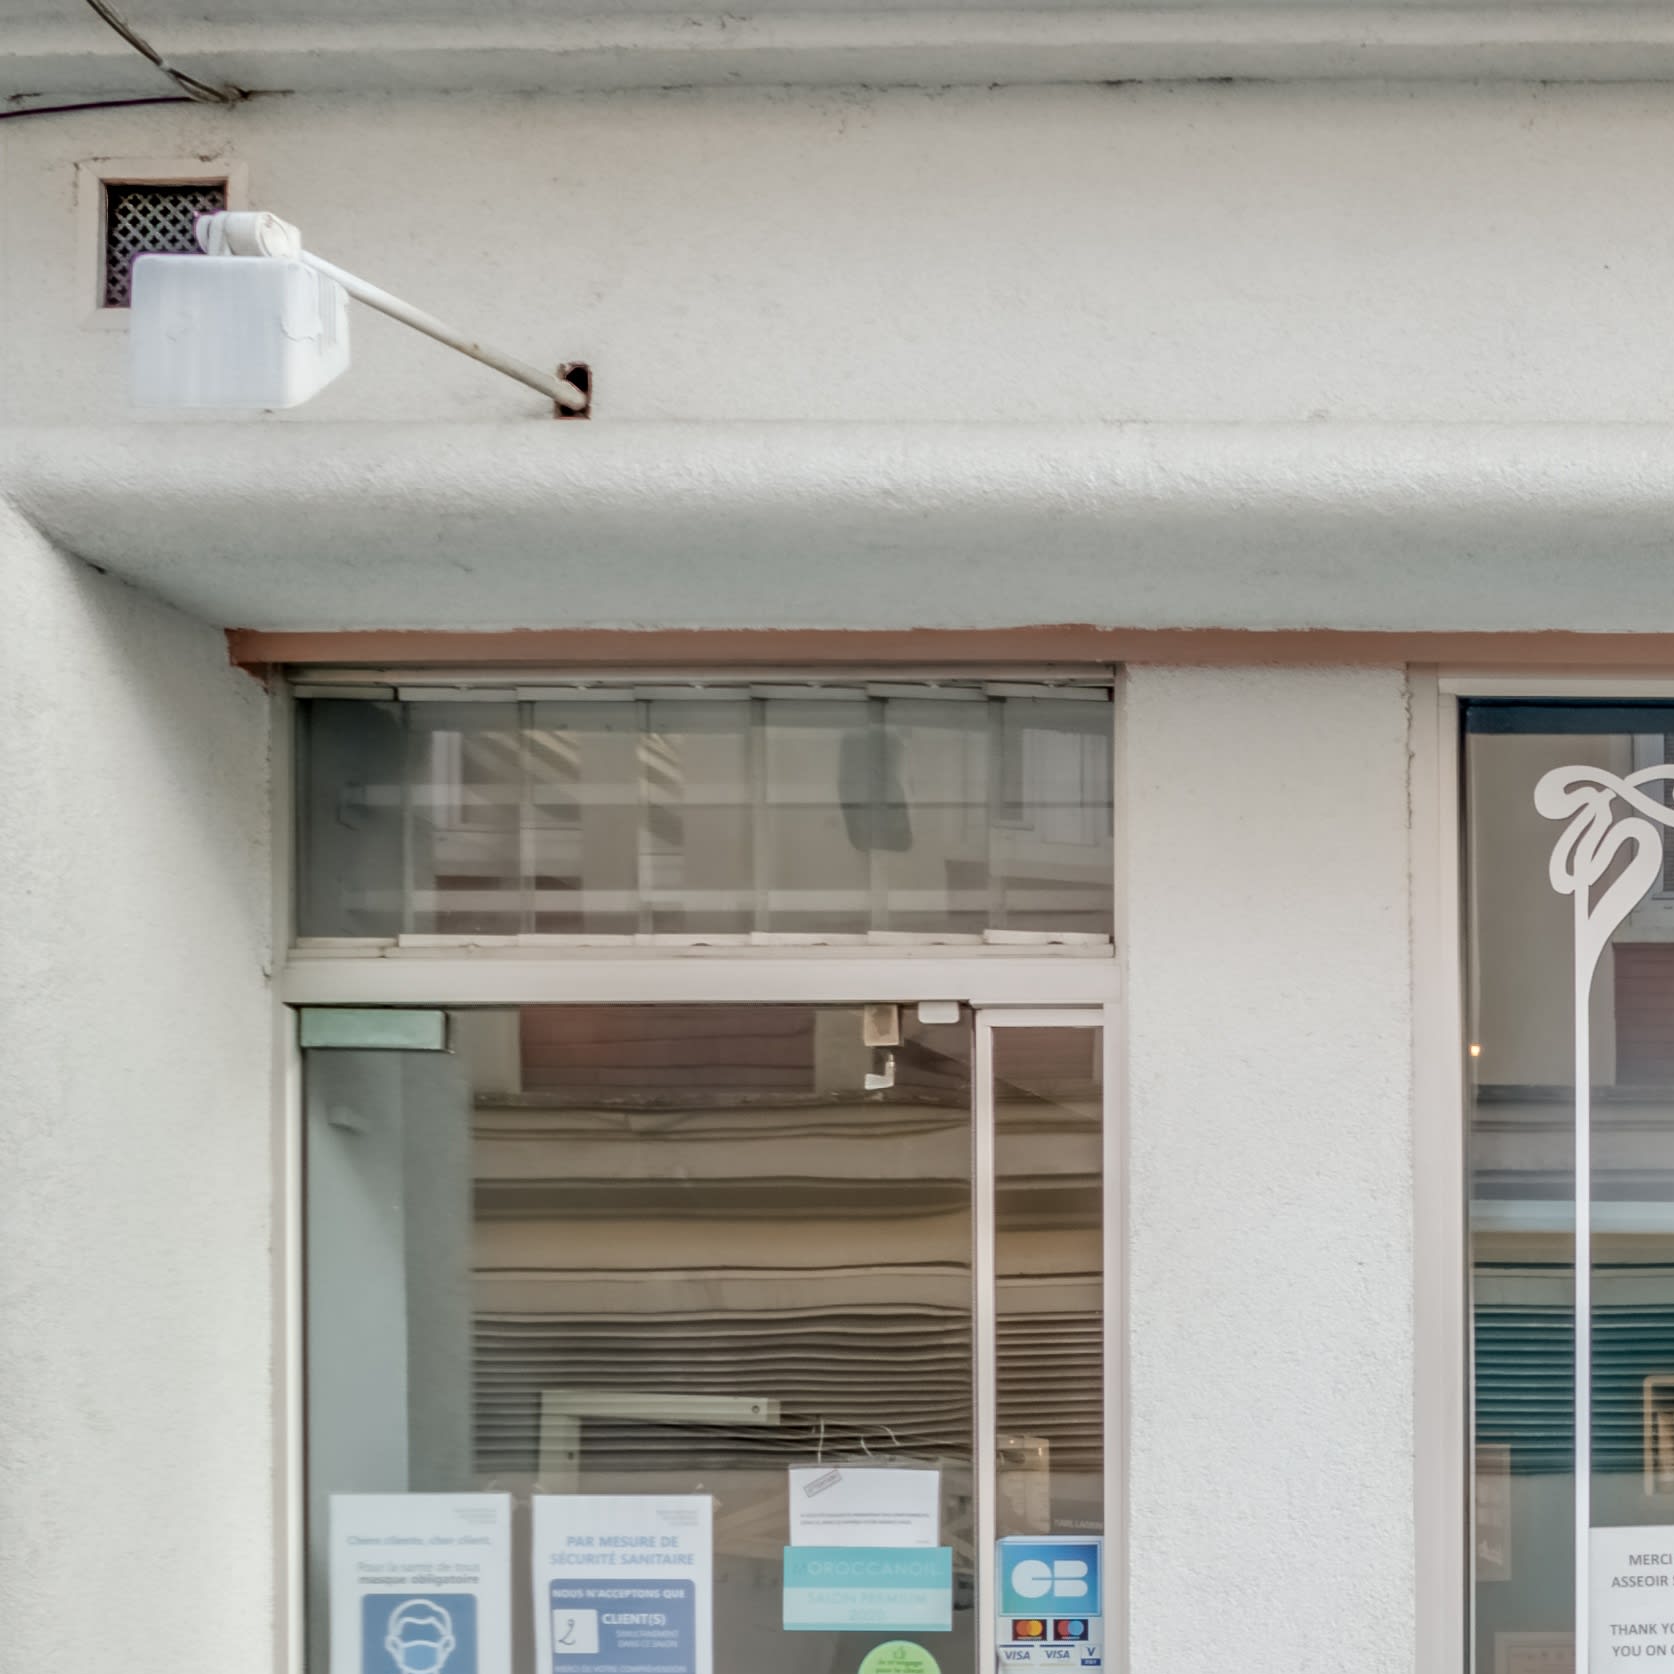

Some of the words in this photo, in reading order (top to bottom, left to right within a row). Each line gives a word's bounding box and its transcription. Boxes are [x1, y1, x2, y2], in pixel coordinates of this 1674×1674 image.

[566, 1536, 594, 1548] PAR
[598, 1536, 657, 1548] MESURE
[660, 1536, 680, 1548] DE
[550, 1551, 617, 1565] SÉCURITÉ
[620, 1553, 695, 1565] SANITAIRE
[1628, 1553, 1672, 1566] MERCI
[357, 1576, 406, 1587] masque
[410, 1573, 480, 1587] obligatoire
[1011, 1559, 1089, 1599] CB
[1611, 1575, 1668, 1588] ASSEOIR
[552, 1588, 584, 1599] NOUS
[586, 1588, 660, 1599] N'ACCEPTONS
[663, 1588, 686, 1599] QUE
[601, 1612, 667, 1626] CLIENT(S)
[1610, 1623, 1658, 1636] THANK
[1004, 1650, 1031, 1661] VISA
[1044, 1650, 1070, 1660] VISA
[1611, 1645, 1641, 1657] YOU
[1645, 1644, 1667, 1657] ON
